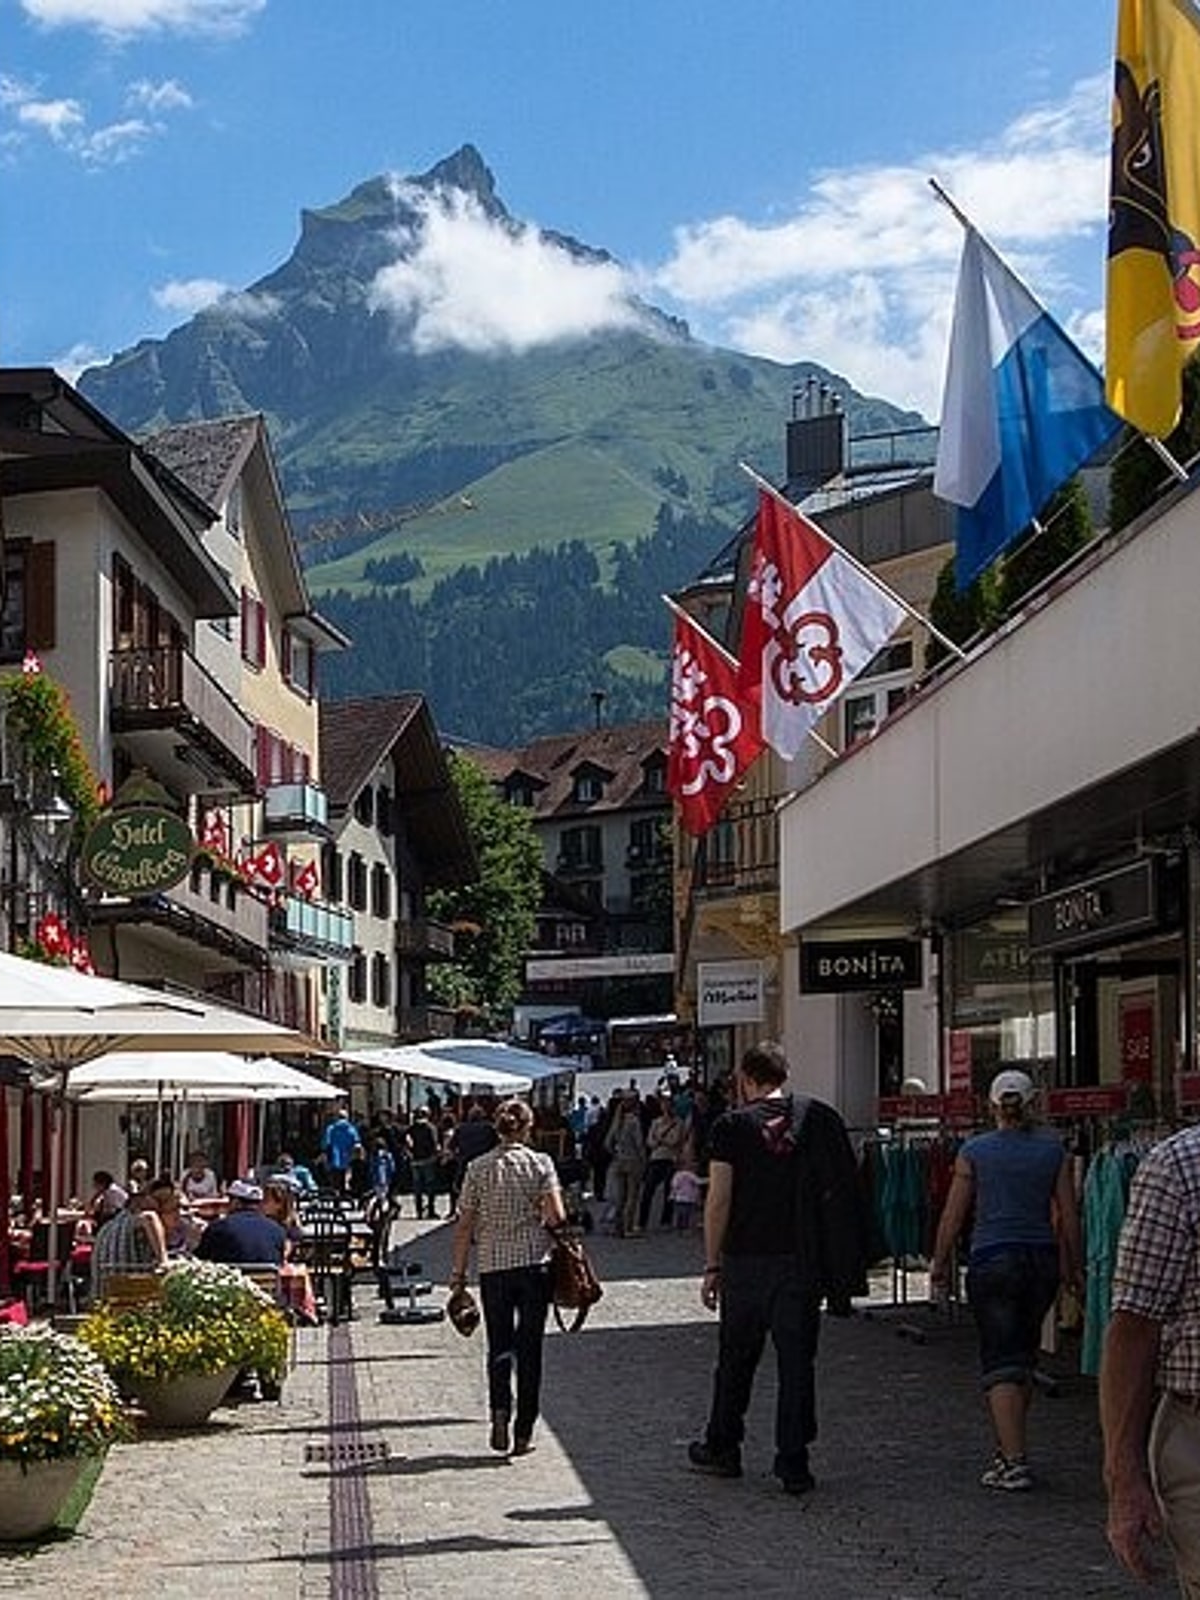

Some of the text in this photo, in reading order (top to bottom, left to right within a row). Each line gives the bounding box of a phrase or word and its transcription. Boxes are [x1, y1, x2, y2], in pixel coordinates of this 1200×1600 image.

[112, 818, 167, 849] Hotel
[92, 850, 187, 889] Engelberg
[1056, 889, 1103, 930] BONITA
[818, 951, 904, 979] BONITA
